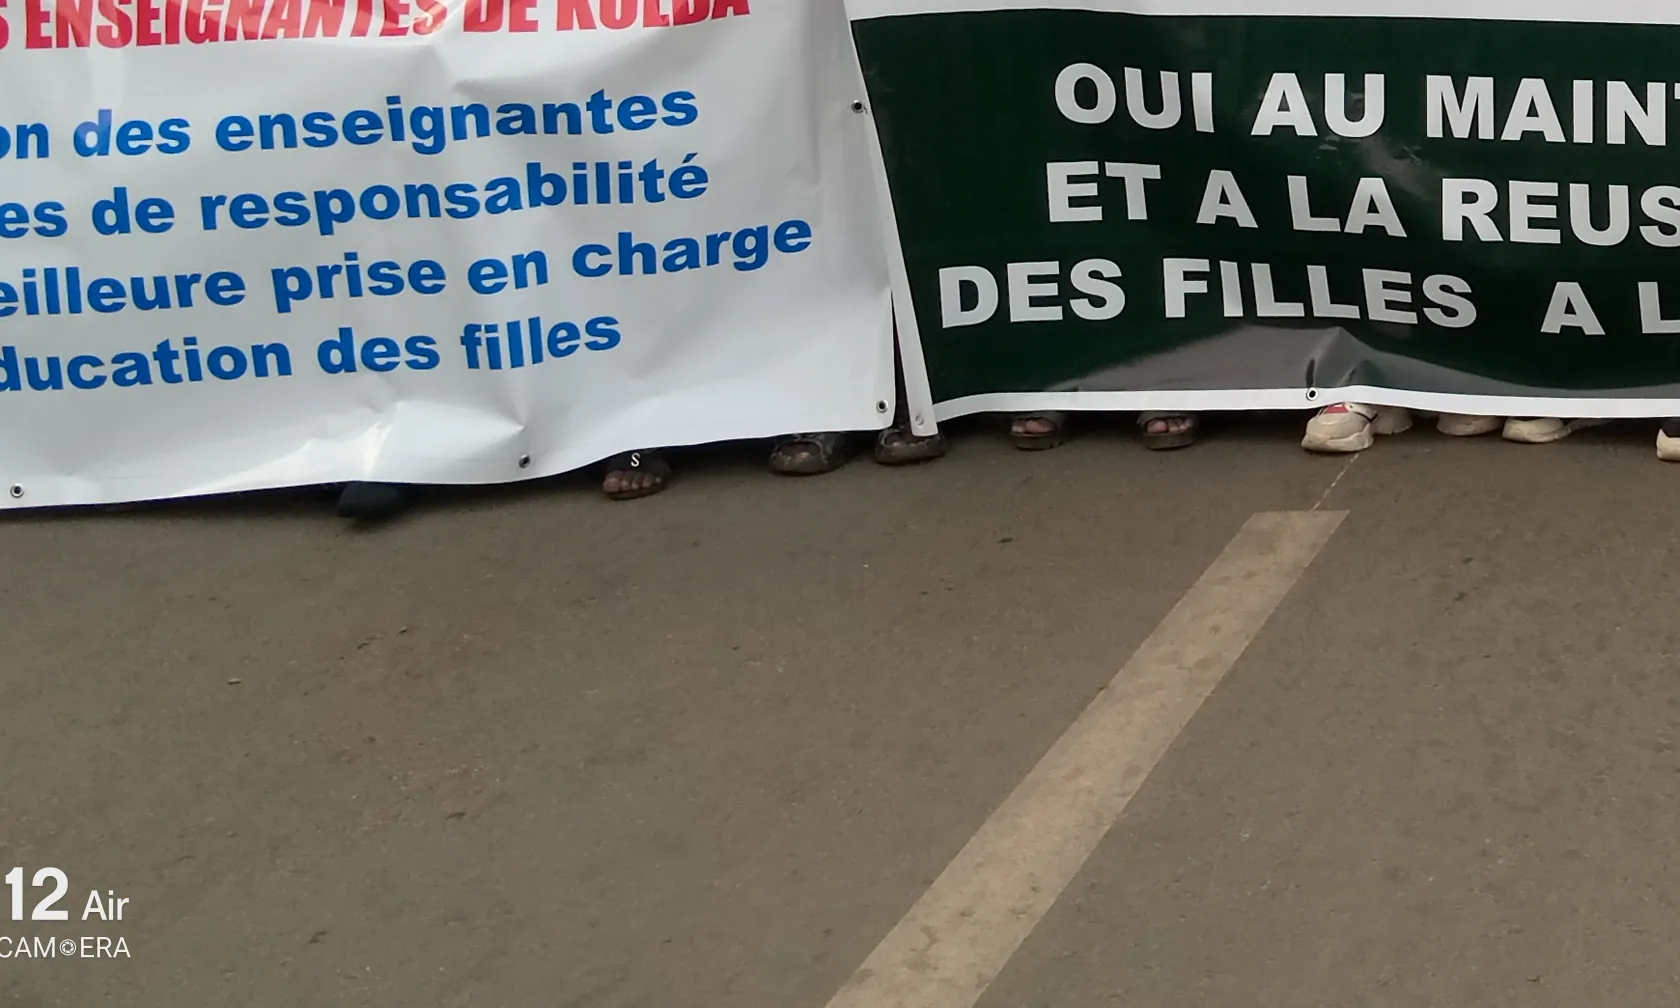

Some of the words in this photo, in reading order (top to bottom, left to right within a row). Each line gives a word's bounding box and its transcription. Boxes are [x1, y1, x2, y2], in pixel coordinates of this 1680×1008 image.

[74, 110, 190, 157] des
[216, 89, 698, 155] enseignantes
[1055, 63, 1214, 132] OUI
[1251, 73, 1384, 137] AU
[92, 187, 174, 235] de
[201, 153, 708, 236] responsabilité
[1047, 161, 1160, 222] ET
[1196, 170, 1258, 228] A
[1288, 176, 1407, 237] LA
[0, 267, 245, 317] eilleure
[272, 252, 446, 313] prise
[468, 251, 548, 294] en
[572, 220, 811, 277] charge
[939, 259, 1125, 328] DES
[1163, 258, 1476, 331] FILLES
[1541, 282, 1605, 335] A
[318, 327, 440, 374] des
[460, 316, 620, 370] filles
